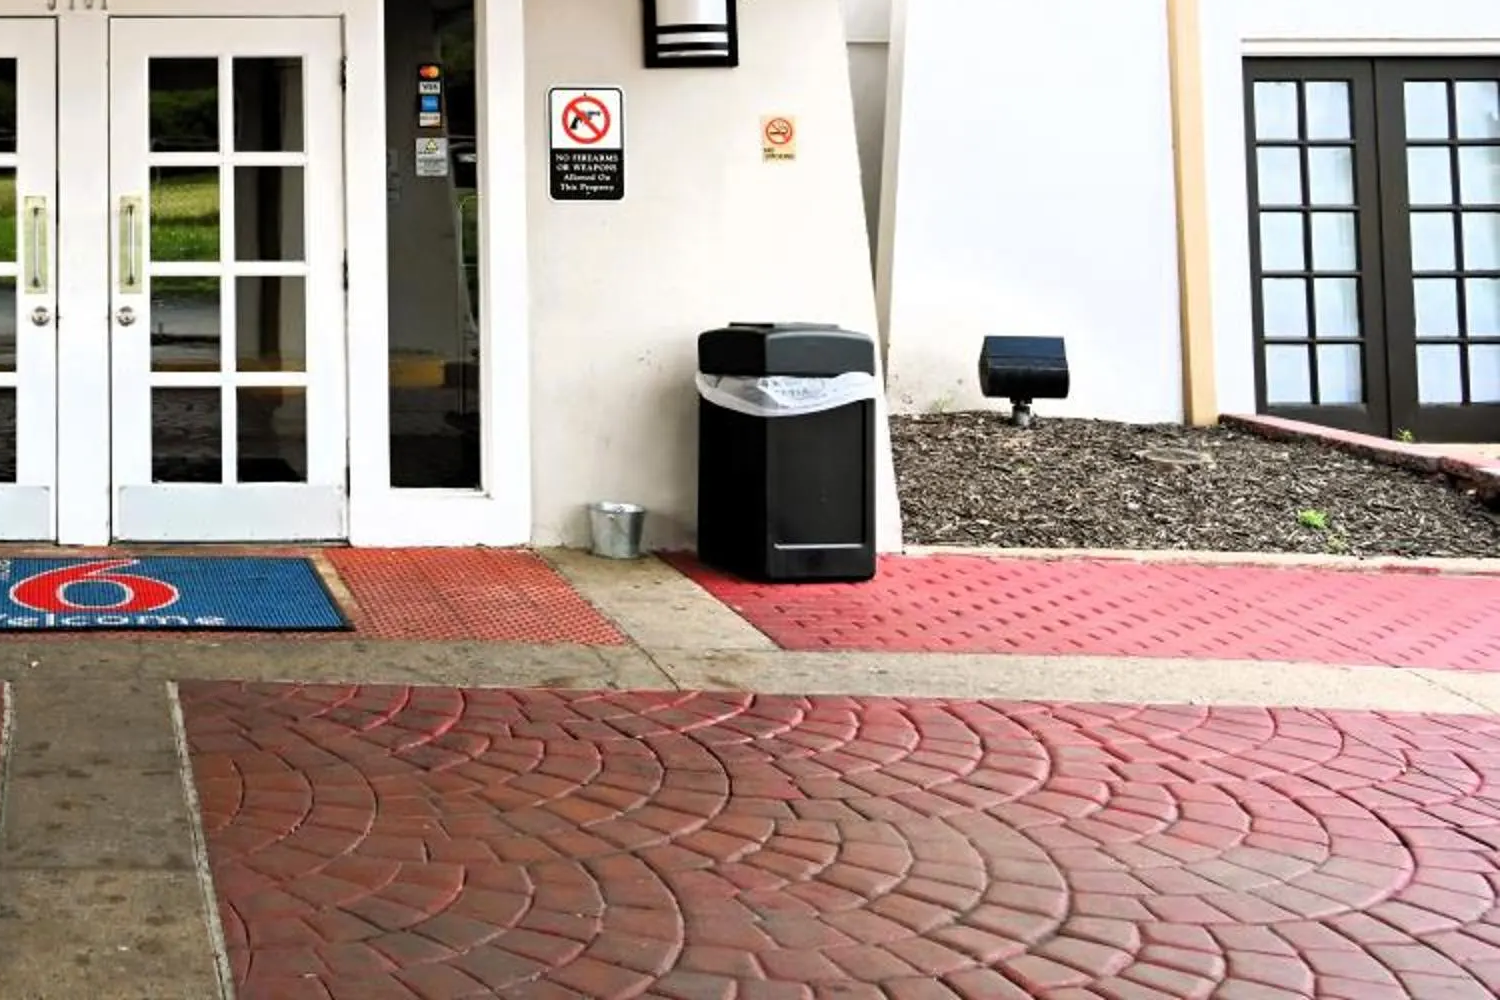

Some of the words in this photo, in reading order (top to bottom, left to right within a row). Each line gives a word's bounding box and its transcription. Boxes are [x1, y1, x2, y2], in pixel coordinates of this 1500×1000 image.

[555, 153, 570, 162] NO
[572, 153, 619, 162] FIREARMS
[556, 163, 569, 171] OR
[572, 163, 618, 172] WEAPONS
[563, 173, 596, 181] Allowed
[597, 173, 611, 181] On
[560, 183, 577, 191] This
[579, 183, 615, 193] Property
